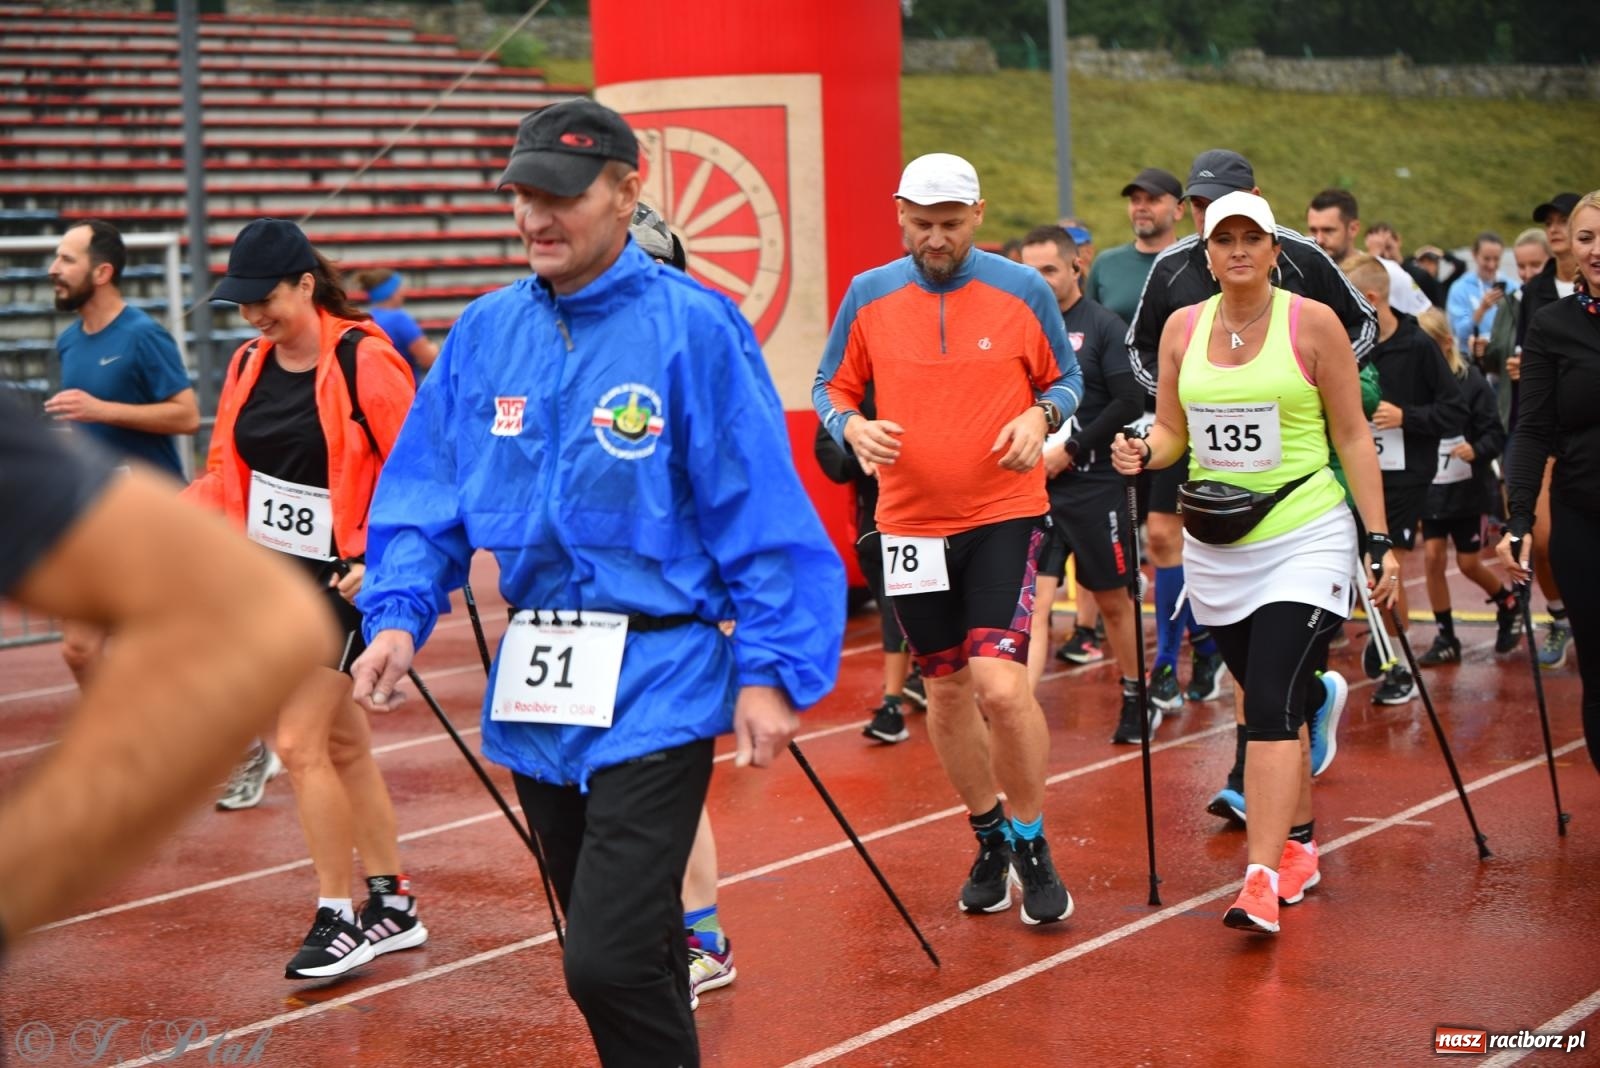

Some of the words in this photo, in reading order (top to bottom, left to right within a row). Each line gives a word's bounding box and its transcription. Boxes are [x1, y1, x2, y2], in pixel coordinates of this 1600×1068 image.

[1231, 332, 1245, 350] A
[1205, 424, 1262, 451] 135
[262, 499, 315, 536] 138
[887, 544, 919, 574] 78
[525, 645, 574, 688] 51
